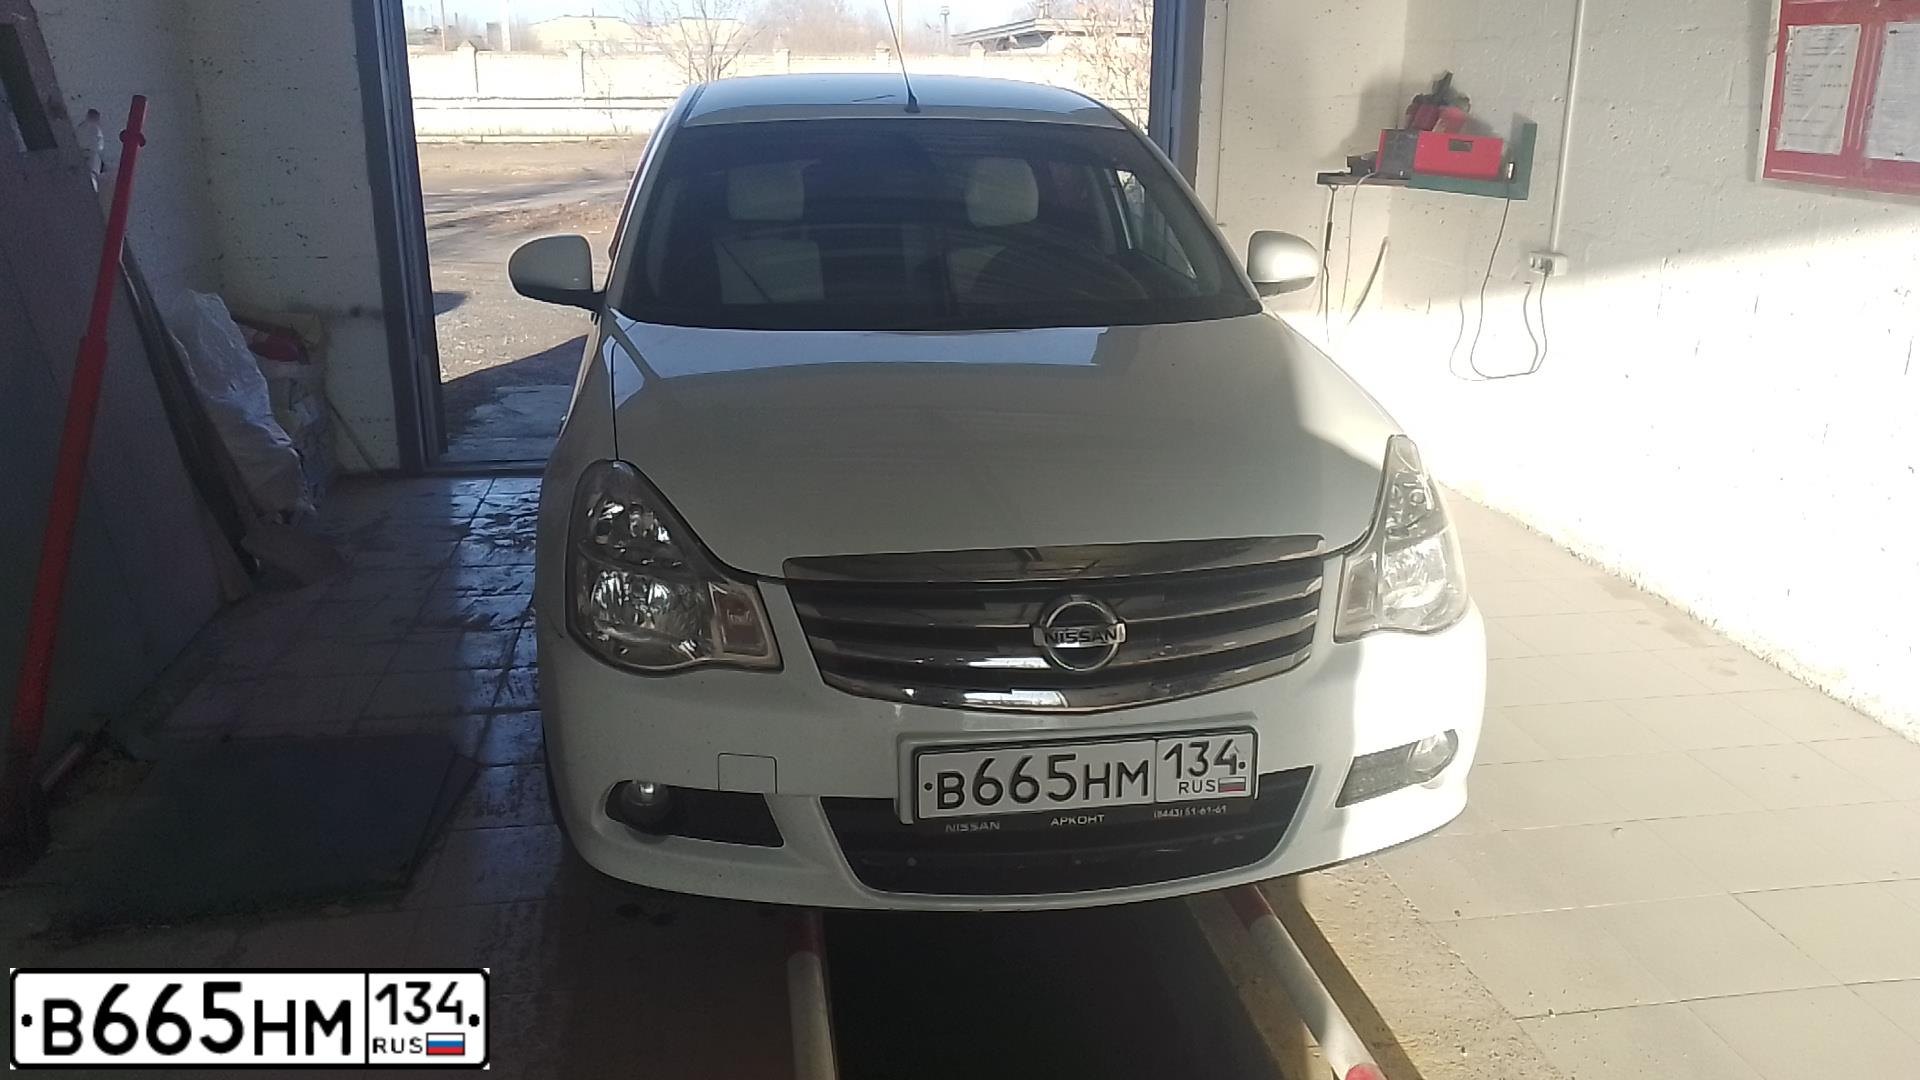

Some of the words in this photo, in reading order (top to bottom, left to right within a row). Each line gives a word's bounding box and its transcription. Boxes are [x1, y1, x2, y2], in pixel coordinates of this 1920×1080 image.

[1045, 626, 1117, 643] NISSAN
[1163, 739, 1237, 779] 134
[1178, 780, 1216, 795] RUS
[945, 821, 1000, 833] NISSAN
